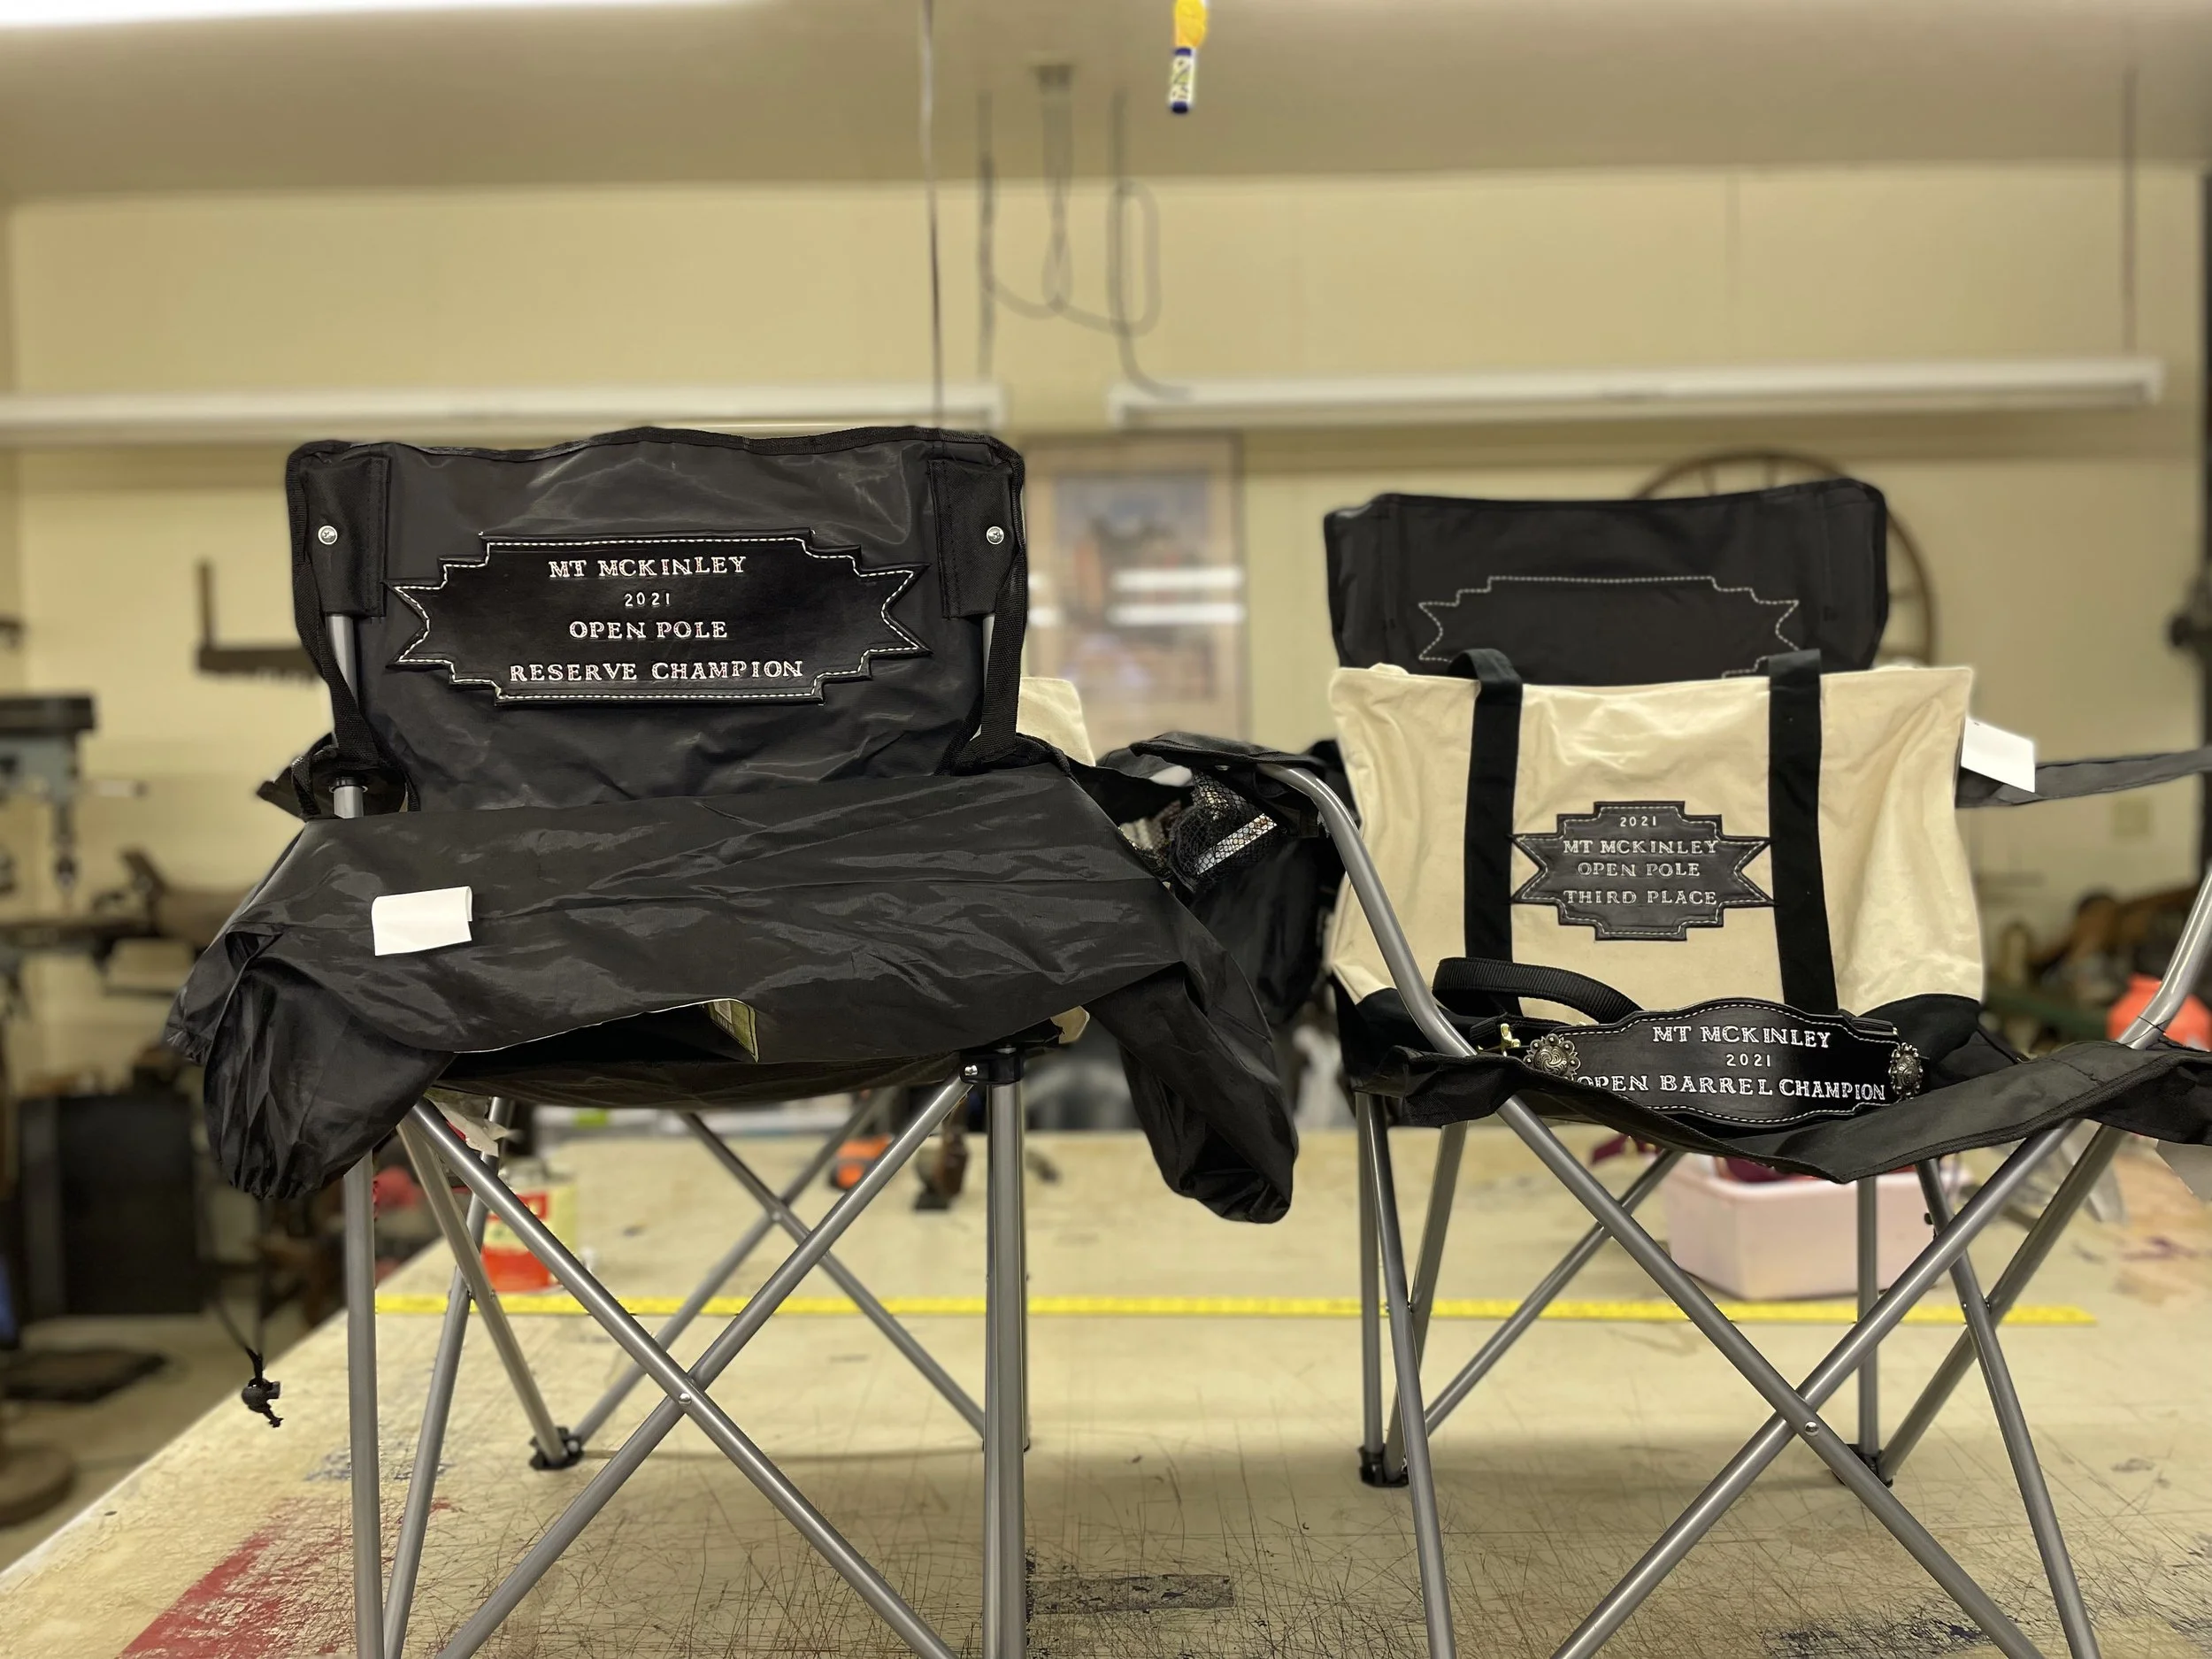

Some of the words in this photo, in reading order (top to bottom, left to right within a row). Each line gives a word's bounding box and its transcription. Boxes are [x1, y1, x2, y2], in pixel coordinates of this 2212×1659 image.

[549, 560, 587, 578] MT
[598, 556, 747, 577] MCKINLEY
[624, 592, 672, 607] 2021
[569, 621, 647, 639] OPEN
[656, 621, 728, 639] POLE
[510, 664, 638, 681] RESERVE
[651, 661, 803, 680] CHAMPION
[1619, 816, 1657, 826] 2021
[1563, 841, 1594, 854] MT
[1600, 840, 1718, 854] MCKINLEY
[1578, 862, 1636, 877] OPEN
[1647, 863, 1701, 877] POLE
[1563, 890, 1637, 904] THIRD
[1647, 890, 1717, 904] PLACE
[1653, 1025, 1692, 1042] MT
[1701, 1025, 1831, 1048] MCKINLEY
[1726, 1054, 1771, 1067] 2021
[1660, 1075, 1772, 1096] BARREL
[1779, 1079, 1886, 1100] CHAMPION
